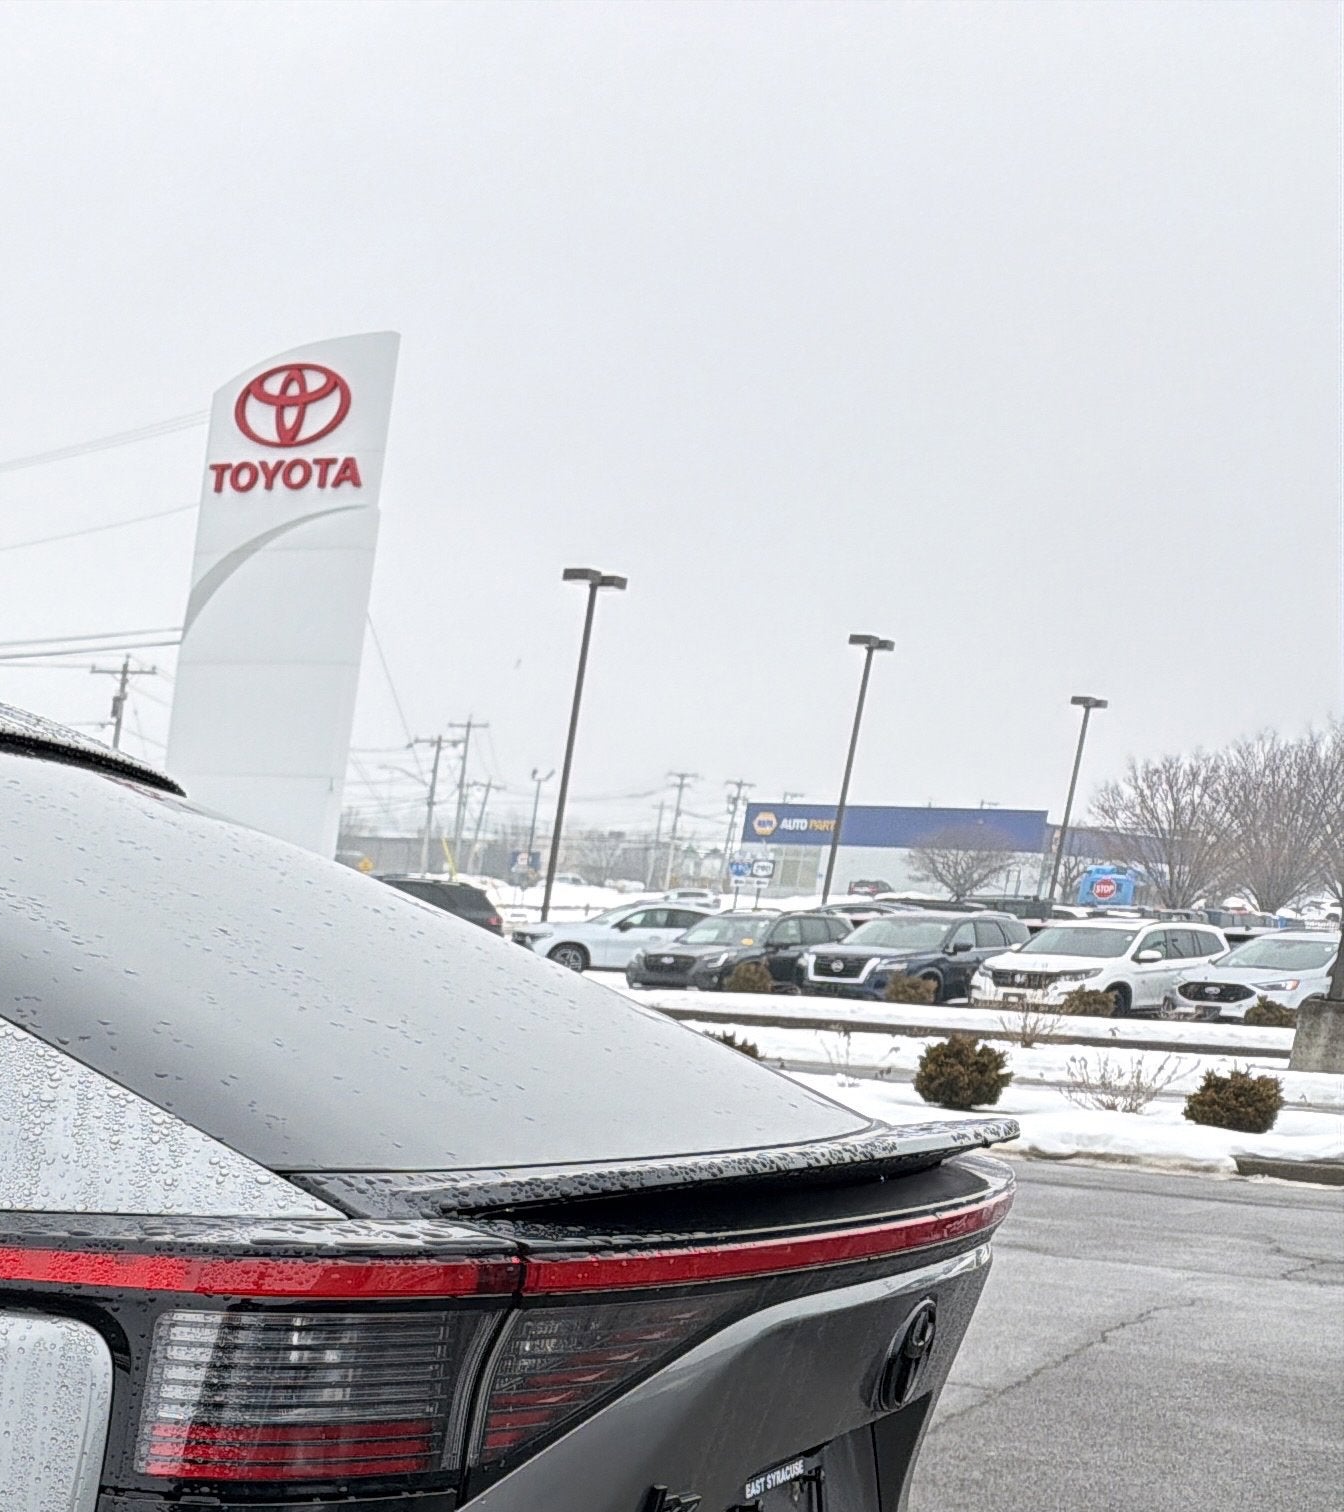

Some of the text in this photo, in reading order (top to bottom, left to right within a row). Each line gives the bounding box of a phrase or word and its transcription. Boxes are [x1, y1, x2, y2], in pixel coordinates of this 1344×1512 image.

[210, 456, 363, 494] TOYOTA
[780, 819, 808, 830] AUTO
[1095, 885, 1114, 893] STOP
[745, 1459, 804, 1499] EAST SYRACUSE
